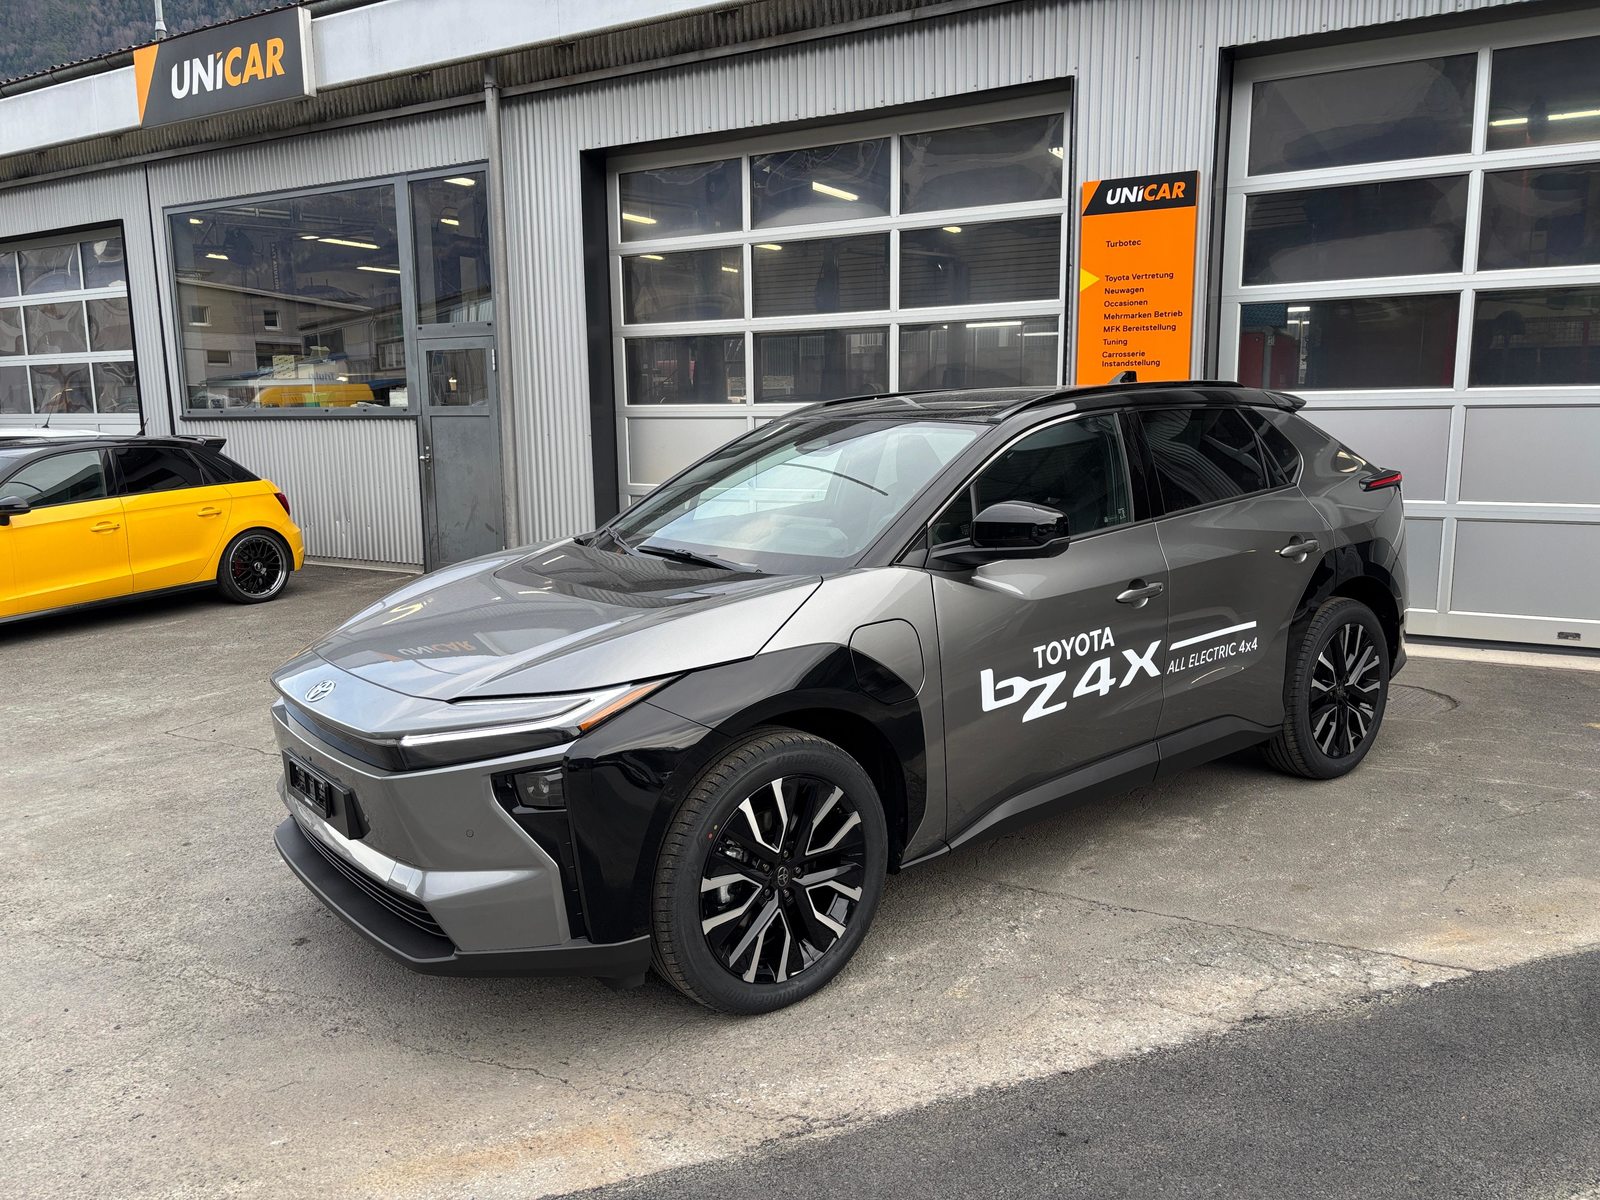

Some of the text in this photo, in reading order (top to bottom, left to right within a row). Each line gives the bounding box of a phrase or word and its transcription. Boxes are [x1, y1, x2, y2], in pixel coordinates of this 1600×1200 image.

[1106, 239, 1142, 248] Turbotec
[1105, 272, 1174, 283] Toyota Vertretung
[1104, 287, 1145, 295] Neuwagen
[1104, 299, 1148, 308] Occasionen
[1103, 310, 1183, 320] Mehrmarken Betrieb
[1122, 323, 1177, 332] Bereitstellung
[1103, 338, 1128, 347] Tuning
[1102, 350, 1146, 358] Carrosserie
[1101, 359, 1161, 368] Instandstellung
[1033, 627, 1115, 668] TOYOTA
[1166, 637, 1258, 675] ALL ELECTRIC 4x4
